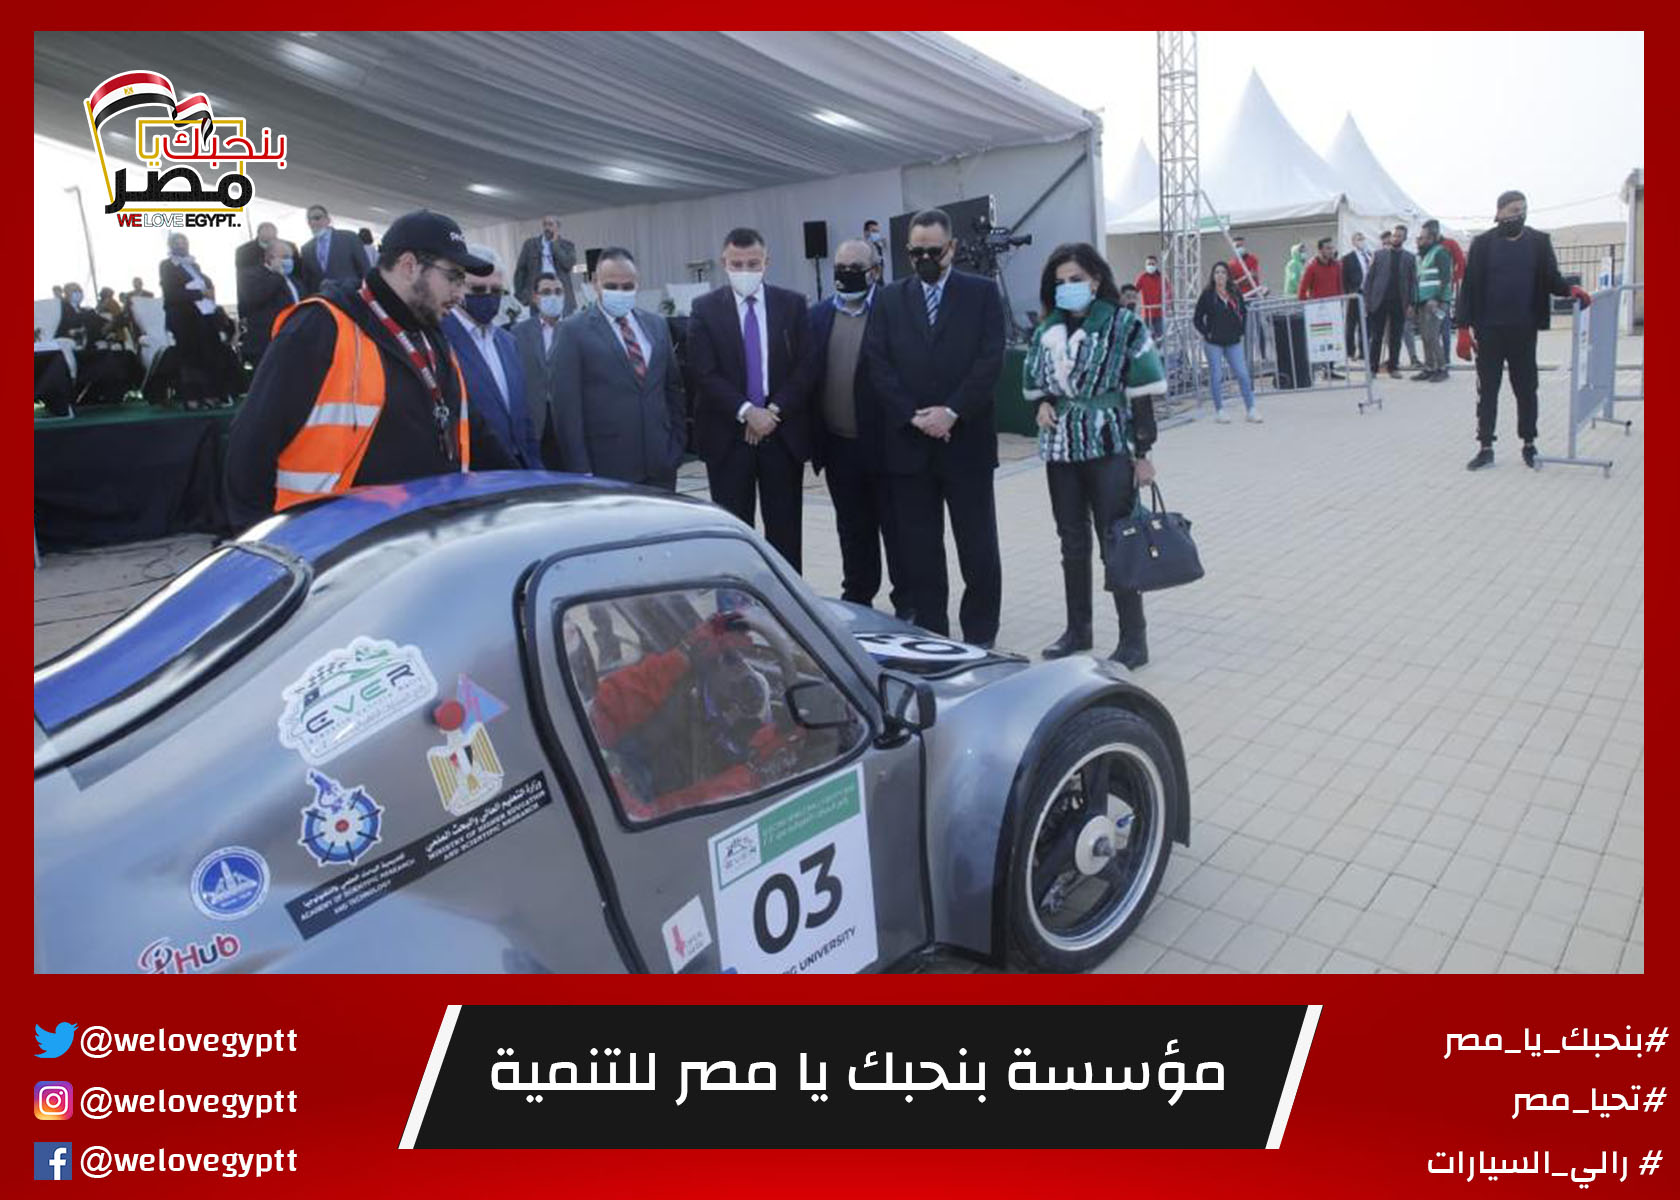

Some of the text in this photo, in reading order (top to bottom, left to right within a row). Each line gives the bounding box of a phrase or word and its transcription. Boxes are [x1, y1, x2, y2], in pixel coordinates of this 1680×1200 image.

[305, 664, 415, 735] EVER
[752, 841, 843, 955] 03
[799, 926, 857, 972] UNIVERSITY
